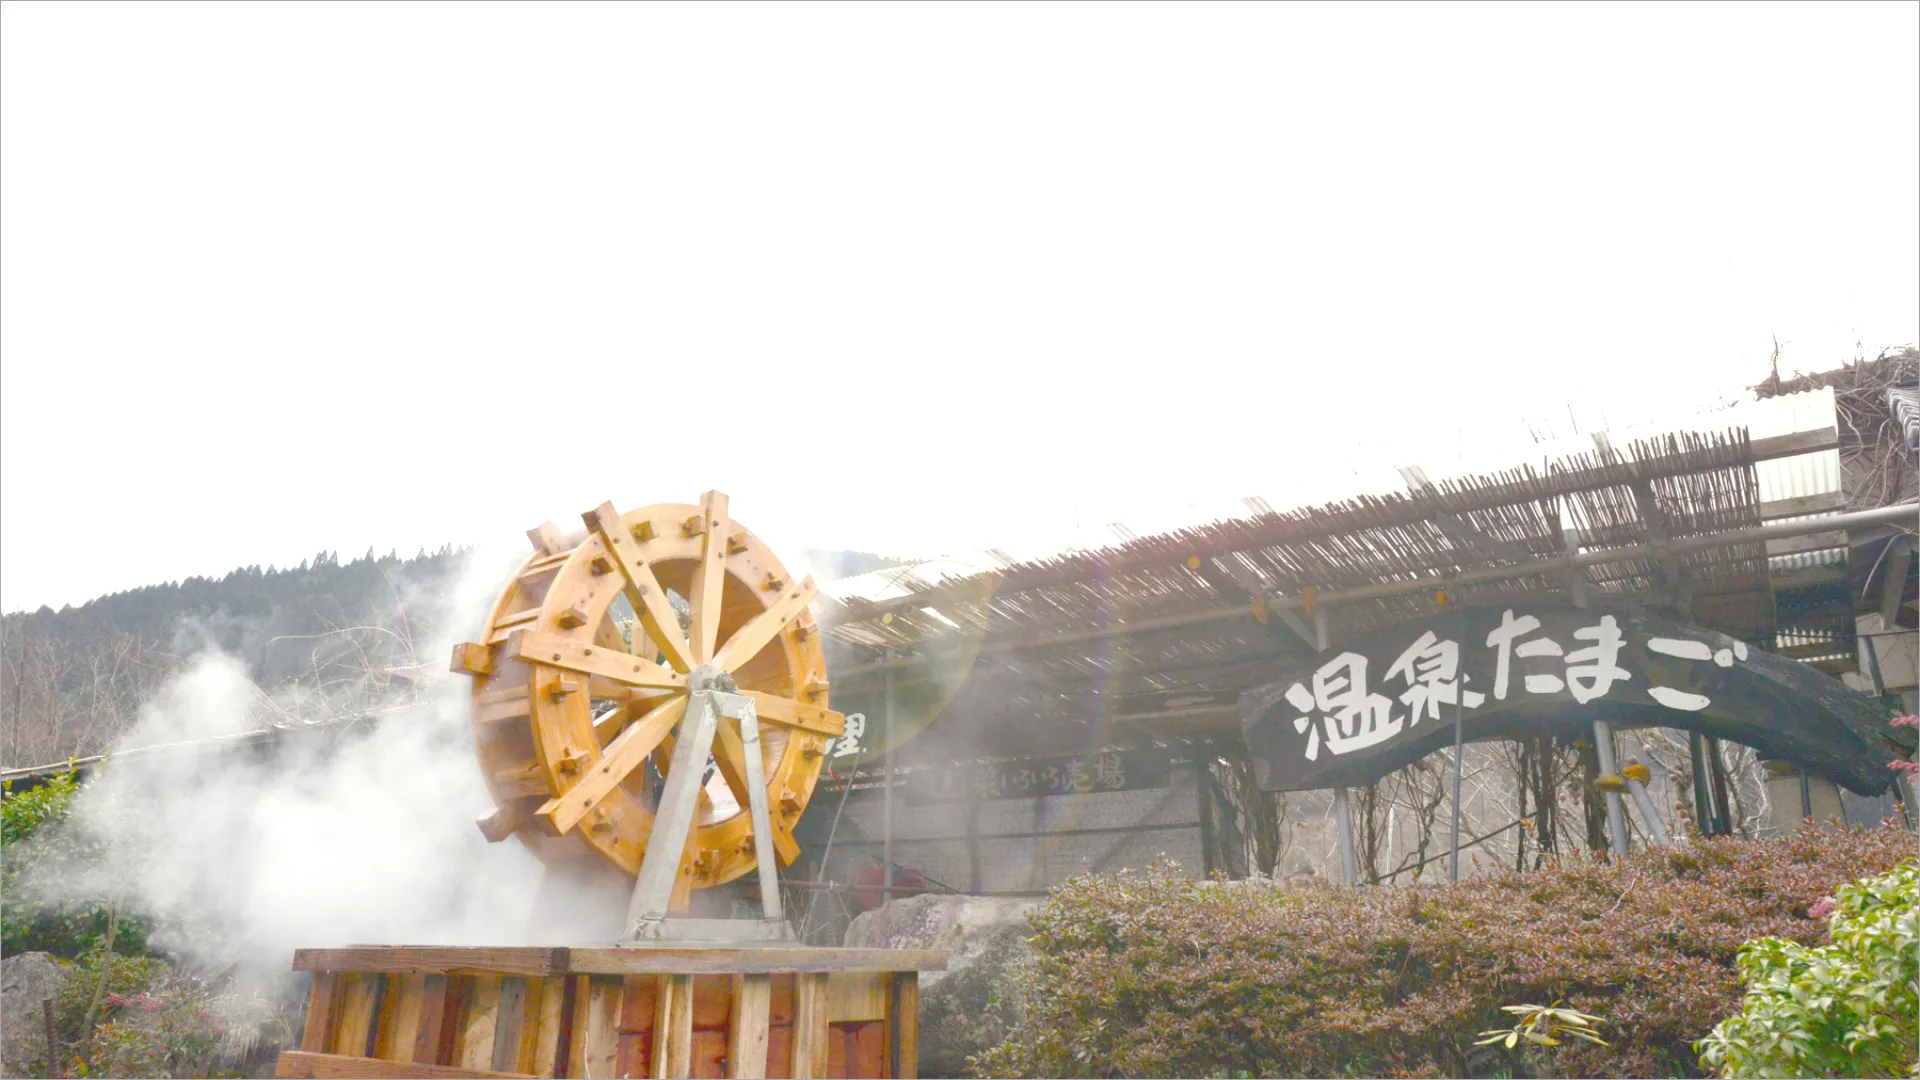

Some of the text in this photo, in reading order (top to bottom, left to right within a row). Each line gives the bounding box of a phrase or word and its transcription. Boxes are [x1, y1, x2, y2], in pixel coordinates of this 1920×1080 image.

[1285, 609, 1748, 760] 温泉たまご
